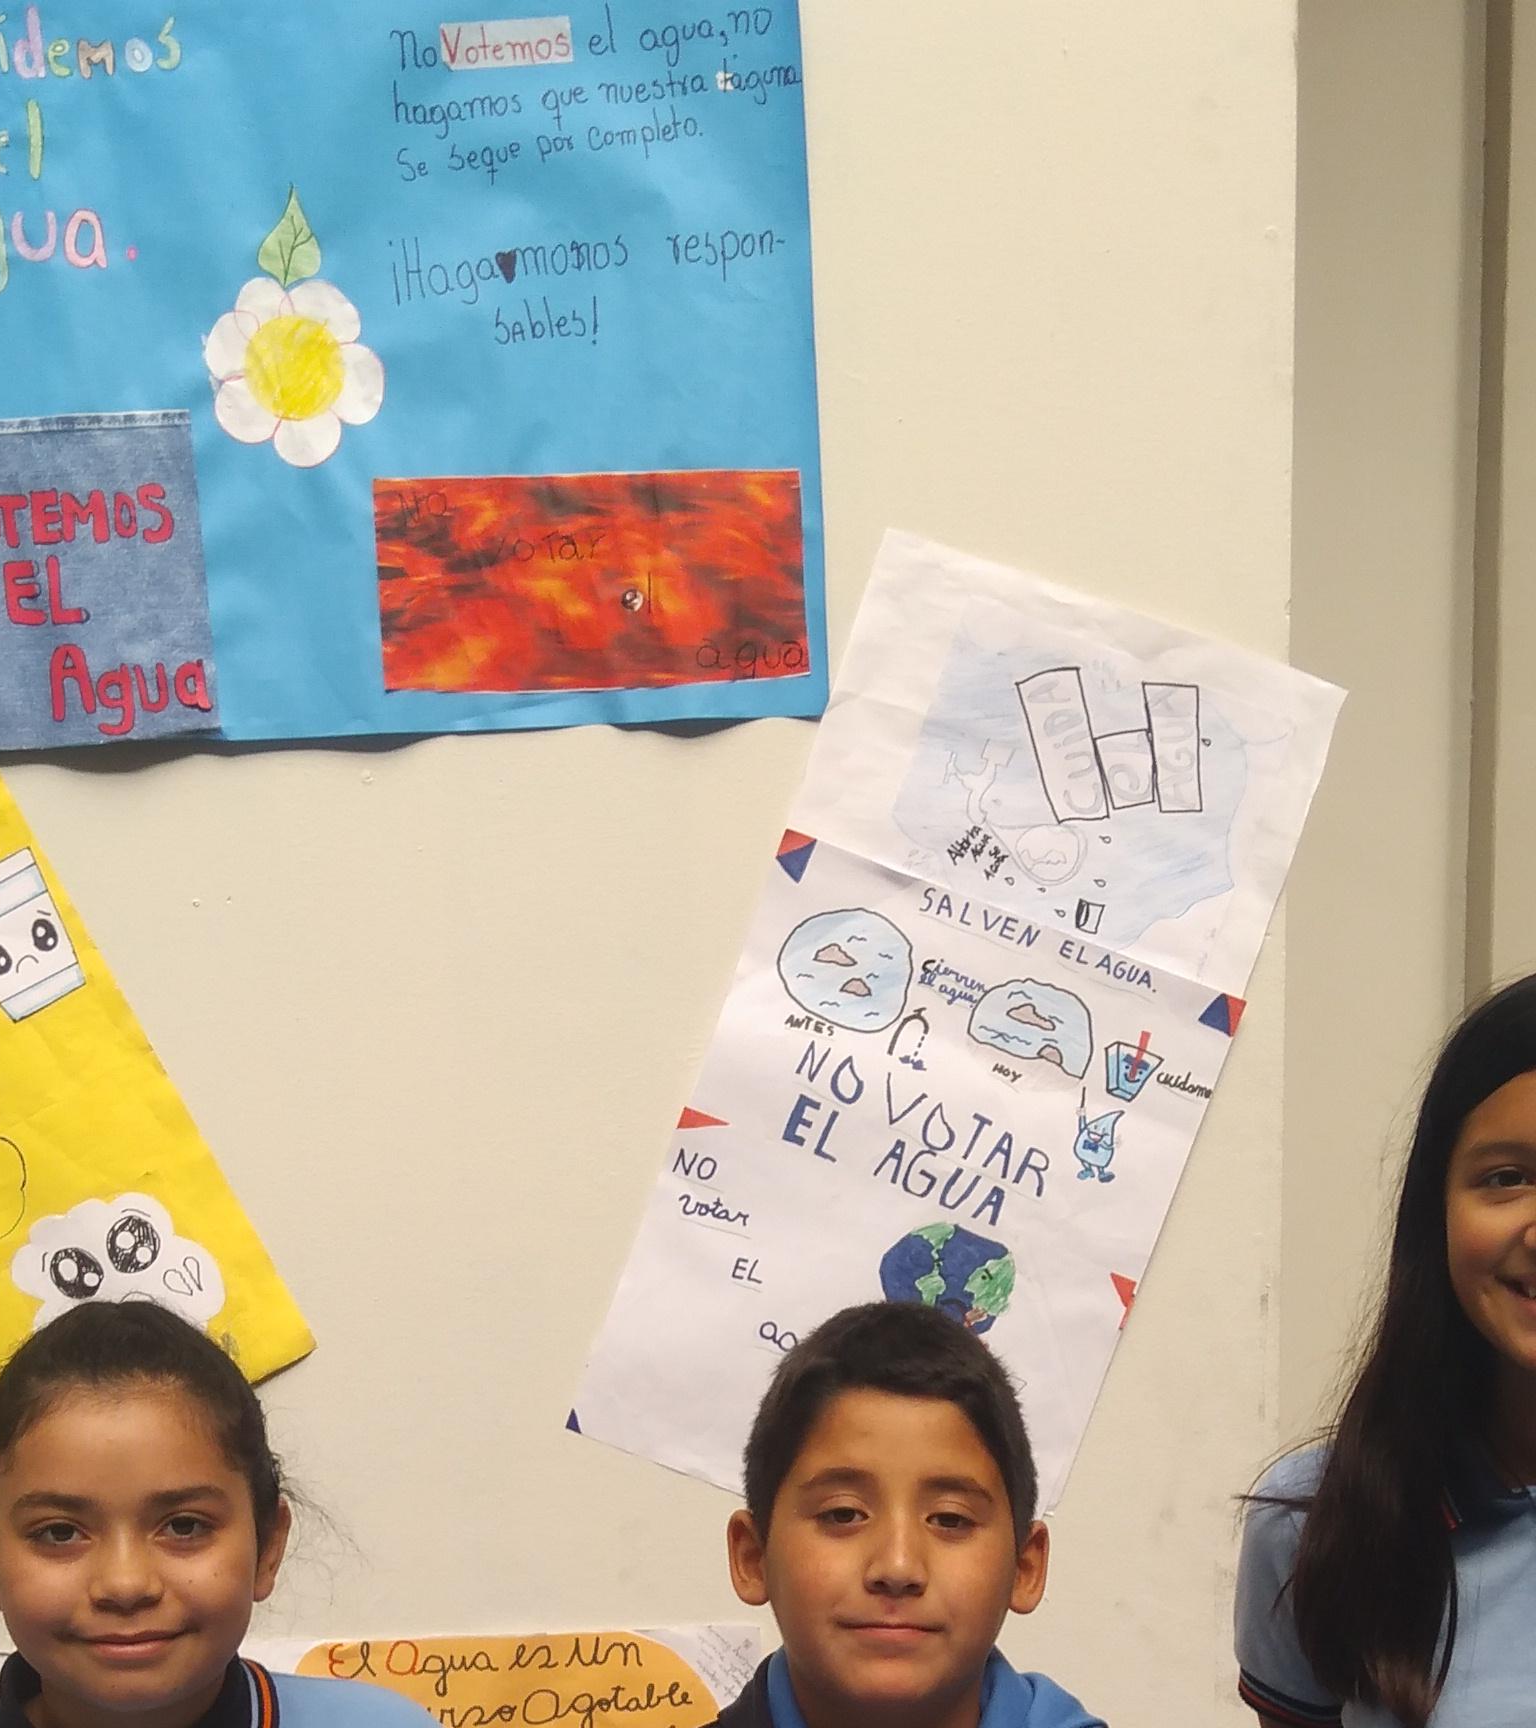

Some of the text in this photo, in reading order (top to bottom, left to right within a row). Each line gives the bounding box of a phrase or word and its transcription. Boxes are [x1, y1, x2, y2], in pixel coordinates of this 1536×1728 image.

[440, 26, 573, 67] Votemos
[587, 2, 617, 56] el
[392, 80, 525, 140] hagamos
[540, 83, 590, 132] que
[603, 70, 710, 106] nuestra
[536, 124, 576, 163] por
[2, 555, 91, 626] EL
[49, 642, 214, 736] Agua
[917, 887, 1042, 949] SALVEN
[1058, 939, 1090, 966] EL
[784, 1013, 835, 1038] ANTES
[795, 1039, 1052, 1197] NO VOTAR
[671, 1146, 719, 1182] NO
[781, 1093, 1008, 1228] EL AGUA
[730, 1256, 763, 1285] EL
